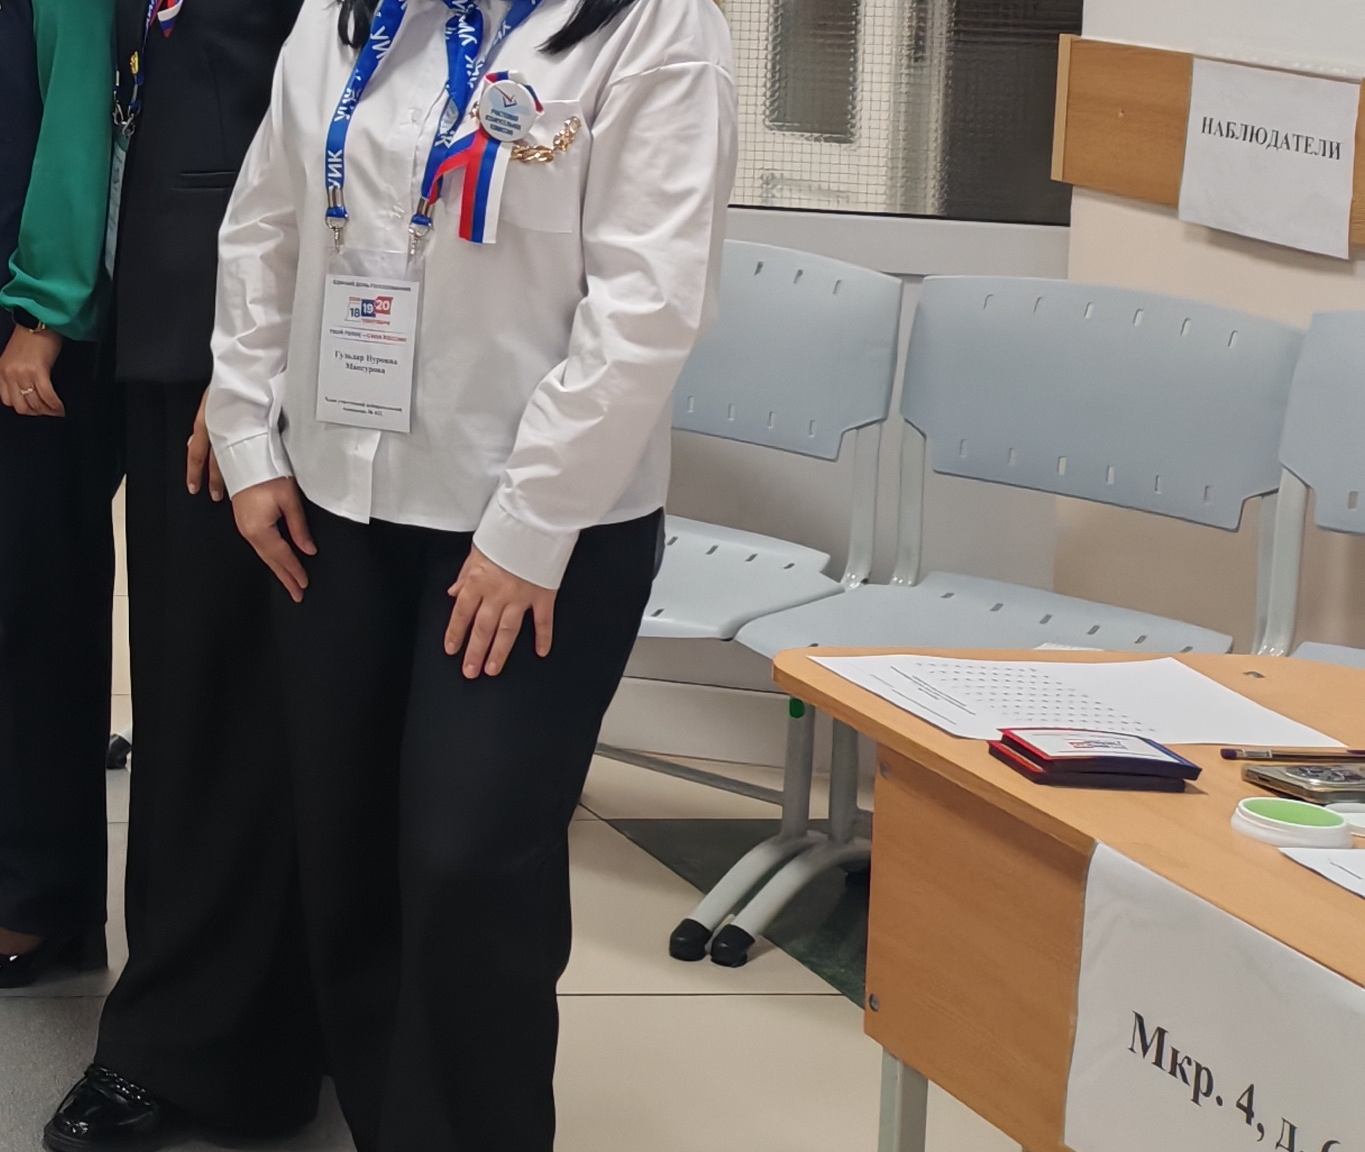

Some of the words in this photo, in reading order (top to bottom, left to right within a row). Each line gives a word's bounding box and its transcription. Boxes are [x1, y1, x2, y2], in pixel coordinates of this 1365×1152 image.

[1201, 116, 1341, 160] НАБЛЮДАТЕЛИ
[327, 149, 344, 191] УИК
[349, 308, 361, 318] 18
[362, 302, 374, 314] 19
[375, 299, 390, 311] 20
[1127, 1010, 1224, 1107] Мкр.
[1236, 1083, 1265, 1142] 4,
